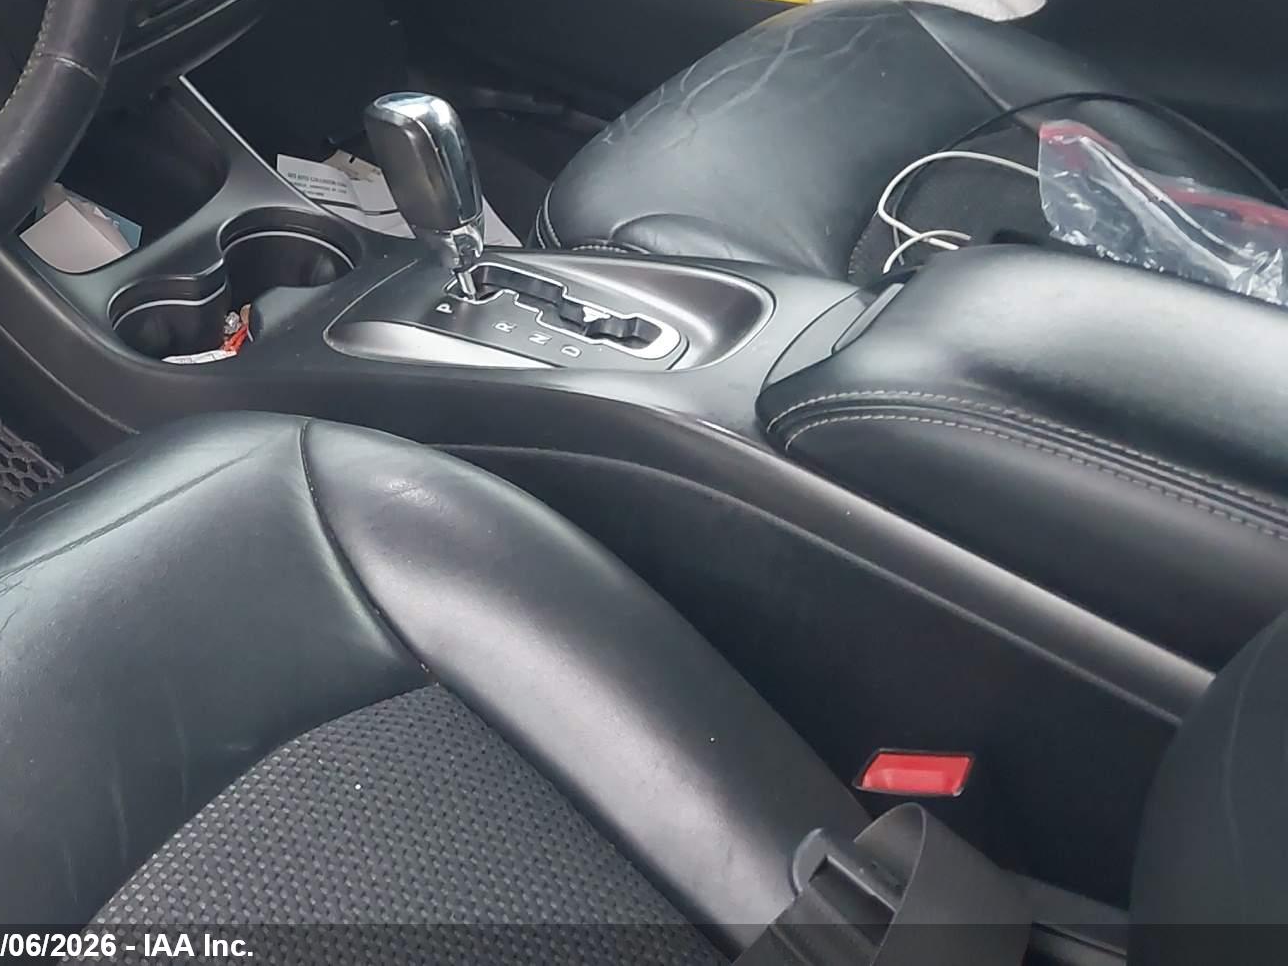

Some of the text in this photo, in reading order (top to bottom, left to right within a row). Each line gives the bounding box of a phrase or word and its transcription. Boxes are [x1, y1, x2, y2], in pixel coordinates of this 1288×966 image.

[436, 303, 582, 357] P R N D
